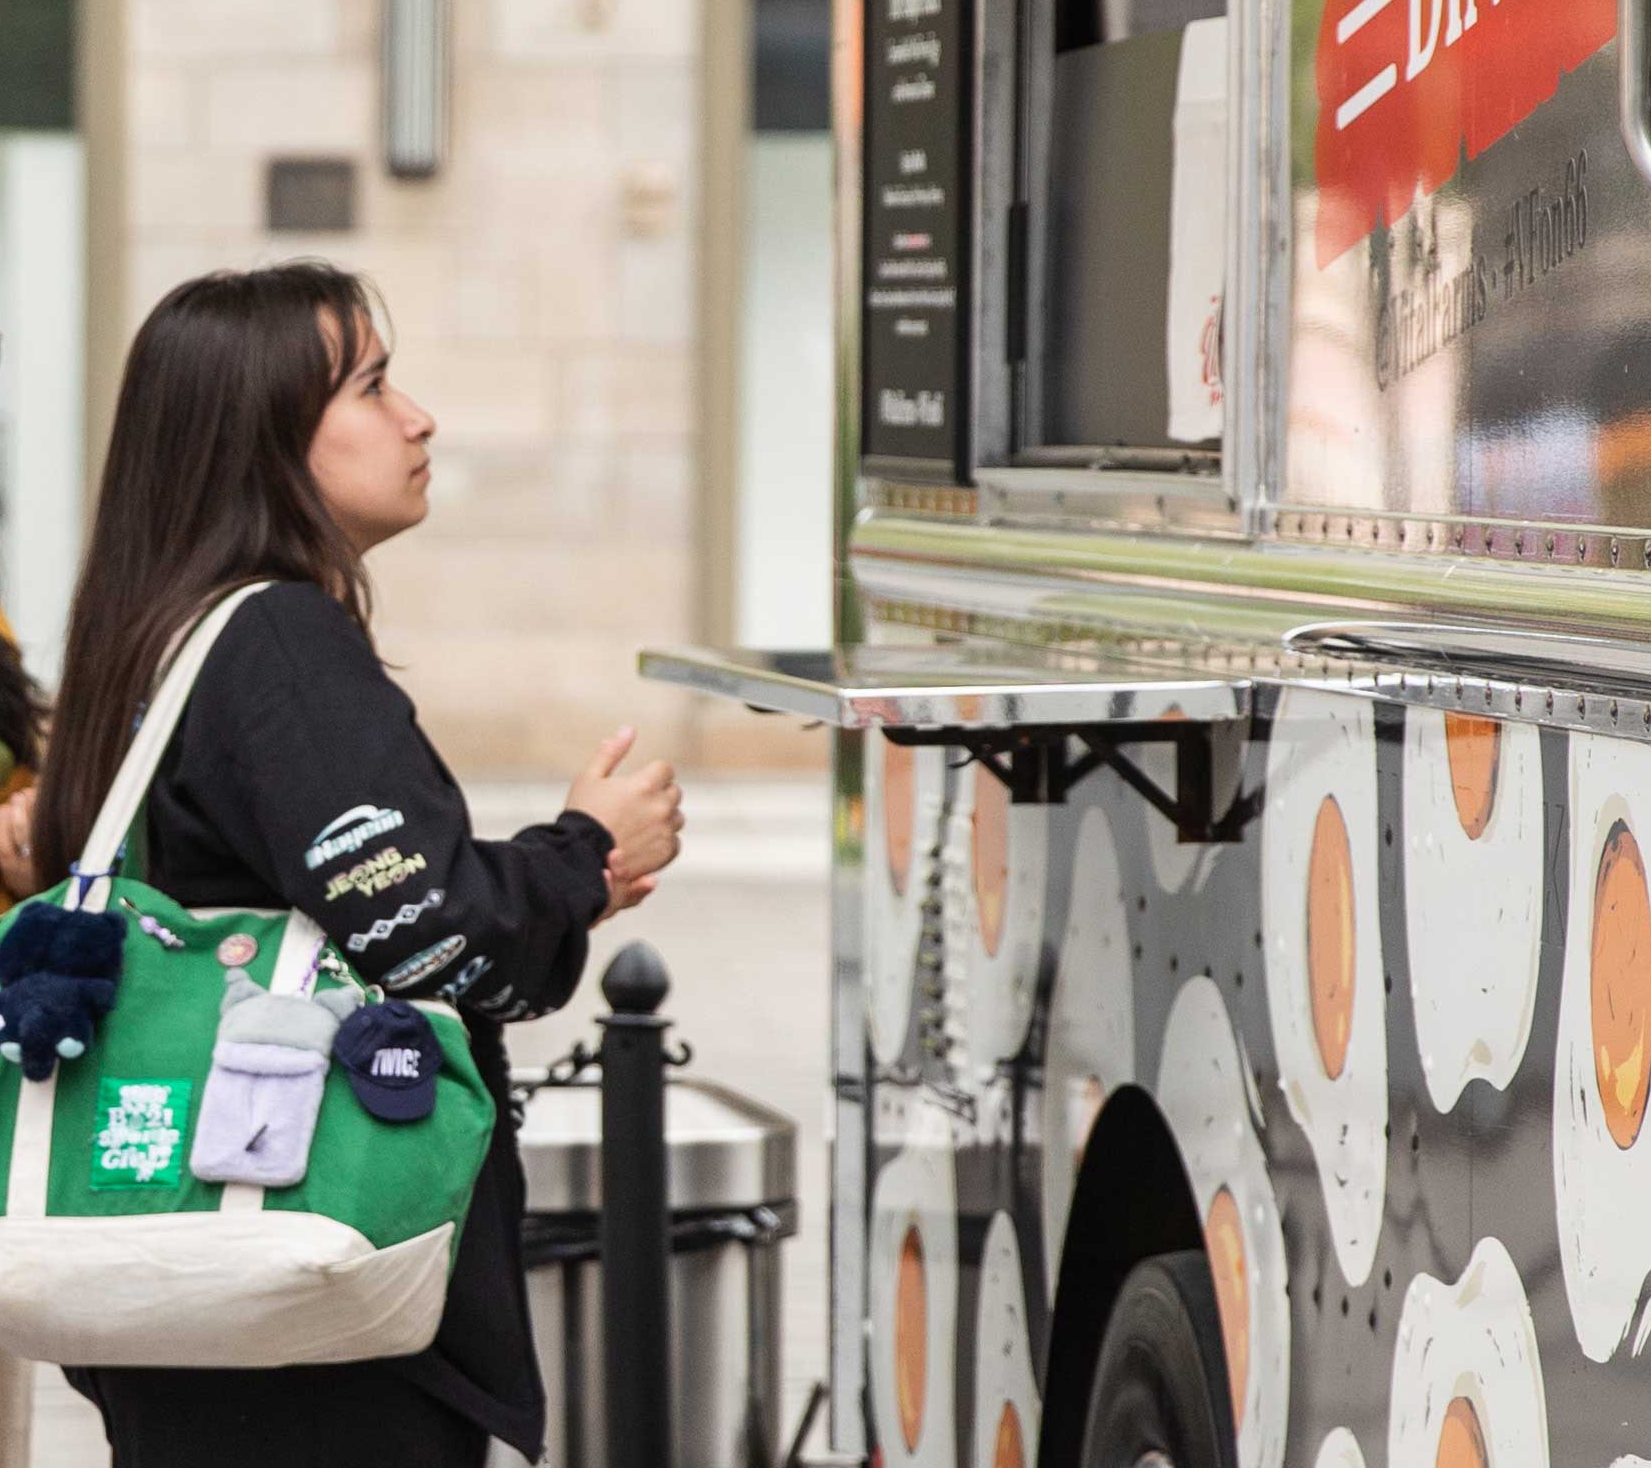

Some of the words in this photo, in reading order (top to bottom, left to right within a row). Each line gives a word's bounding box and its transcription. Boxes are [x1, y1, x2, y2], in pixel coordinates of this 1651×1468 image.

[324, 846, 403, 901] JEONG
[355, 852, 427, 898] YEON
[371, 1047, 422, 1078] TWICE
